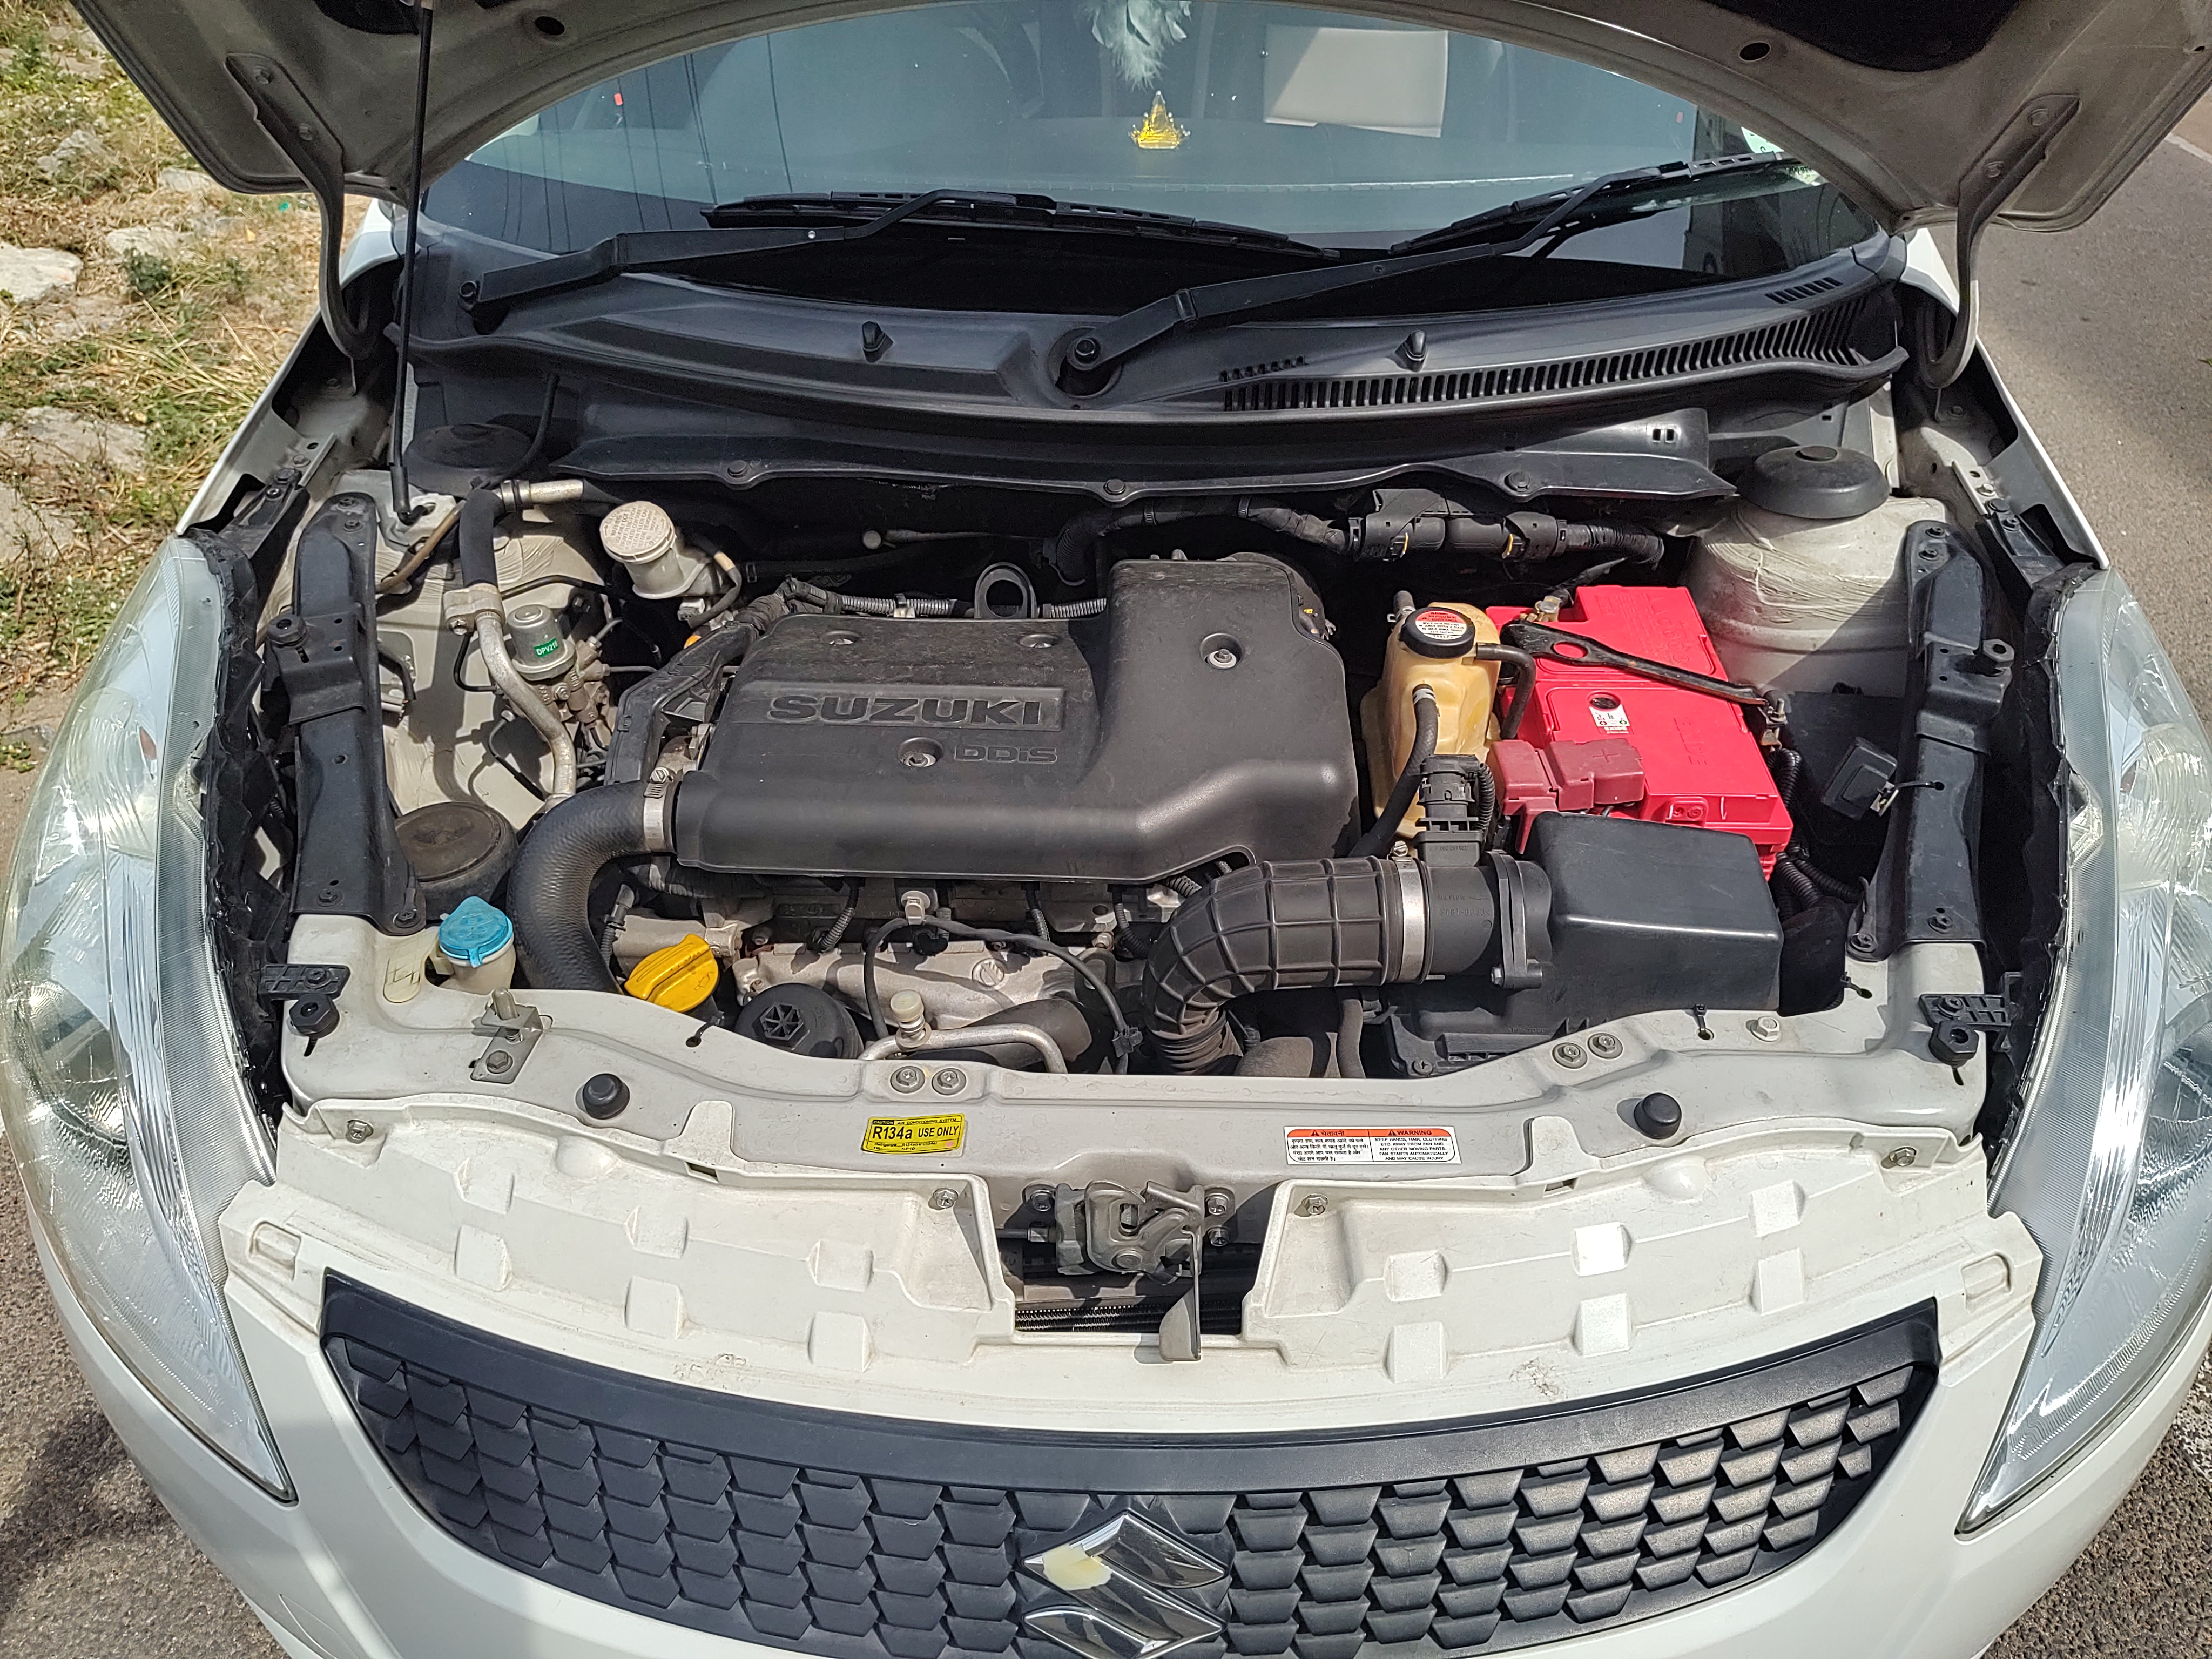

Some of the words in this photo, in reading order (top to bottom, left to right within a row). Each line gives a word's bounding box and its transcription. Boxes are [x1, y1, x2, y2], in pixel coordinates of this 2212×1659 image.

[769, 696, 1040, 726] SUZUKI
[872, 1126, 913, 1139] R134a
[918, 1127, 935, 1137] USE
[937, 1125, 959, 1136] ONLY
